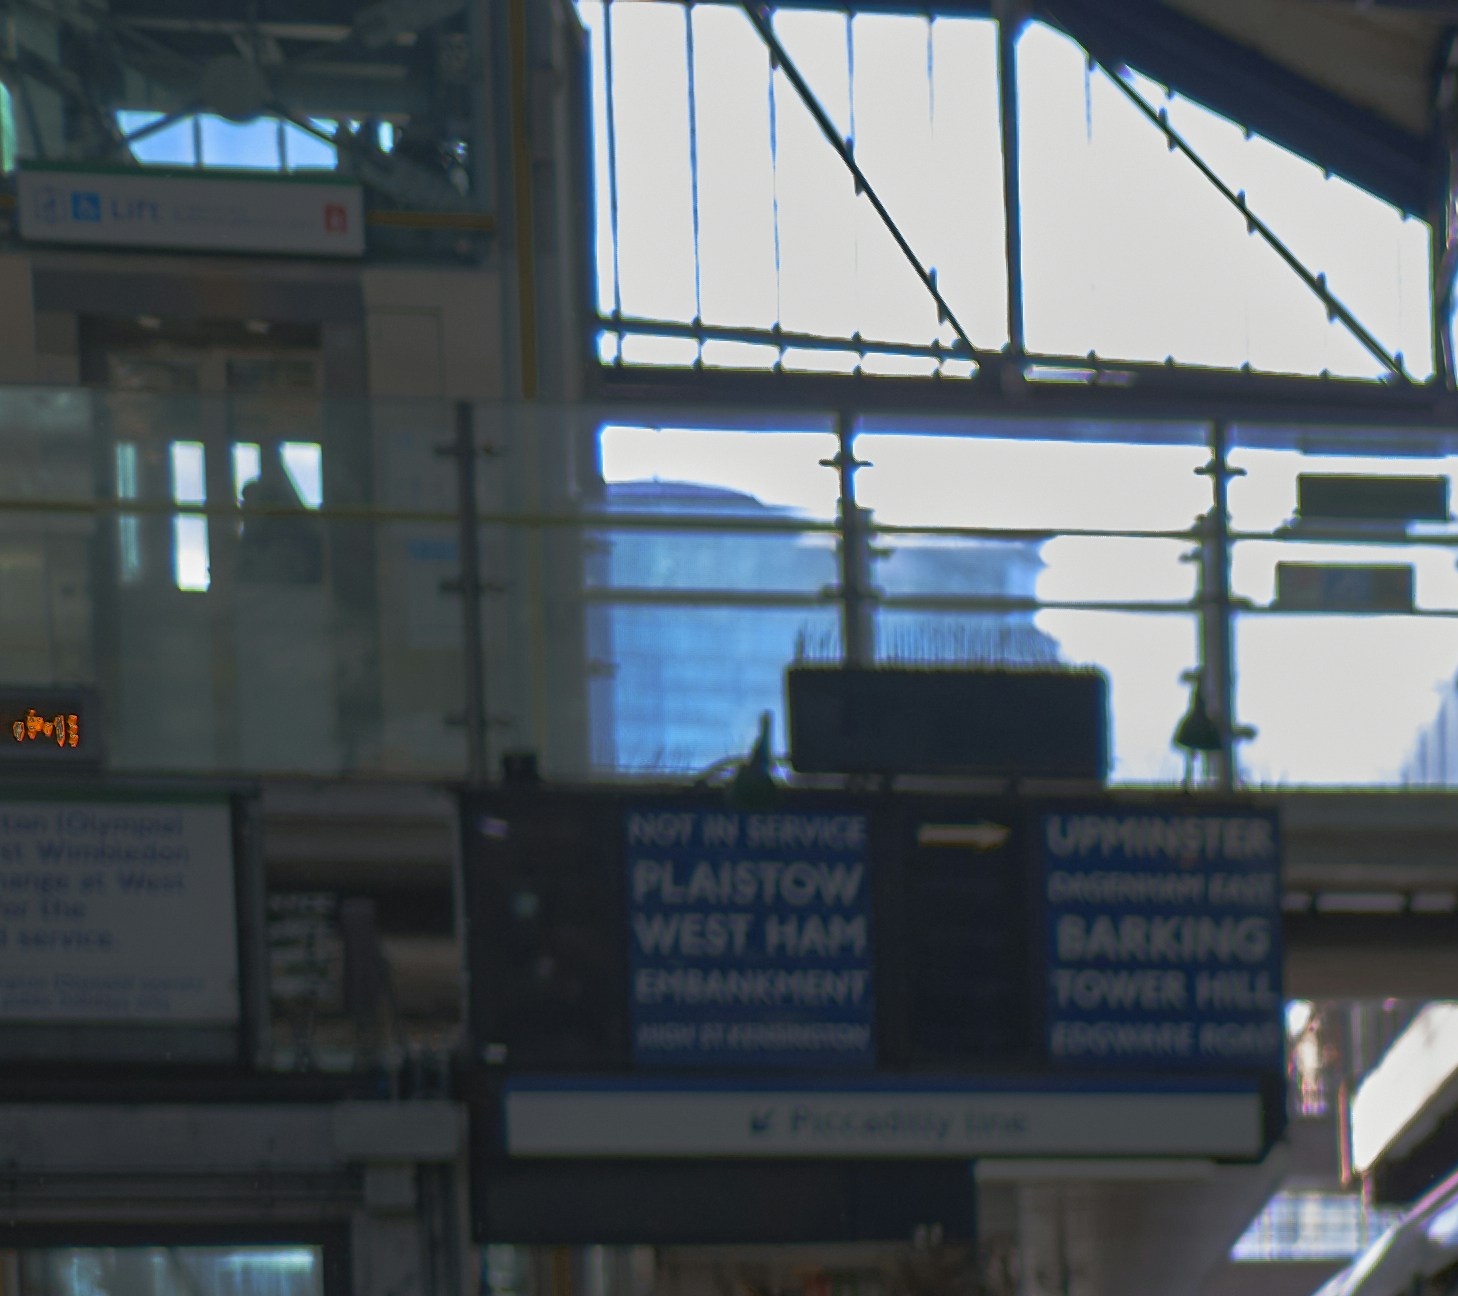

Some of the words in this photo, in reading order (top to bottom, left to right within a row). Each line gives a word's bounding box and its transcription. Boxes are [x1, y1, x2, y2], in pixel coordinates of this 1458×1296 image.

[111, 199, 160, 223] Lift
[628, 813, 697, 847] NOT
[702, 814, 738, 848] IN
[746, 815, 867, 850] SERVICE
[1047, 815, 1274, 861] UPMINSTER
[36, 840, 190, 865] Wimbledon
[633, 860, 865, 907] PLAISTOW
[1048, 871, 1204, 905] DAGENHAM
[1208, 873, 1275, 906] EAST
[634, 912, 754, 957] WEST
[765, 914, 868, 958] HAM
[1057, 914, 1272, 963] BARKING
[635, 967, 869, 1006] EMBANKMENT
[1050, 968, 1187, 1011] TOWER
[1195, 970, 1279, 1012] HILL
[1051, 1021, 1195, 1058] EDGWARE
[790, 1103, 950, 1140] Piccadilly
[965, 1106, 1028, 1135] line
